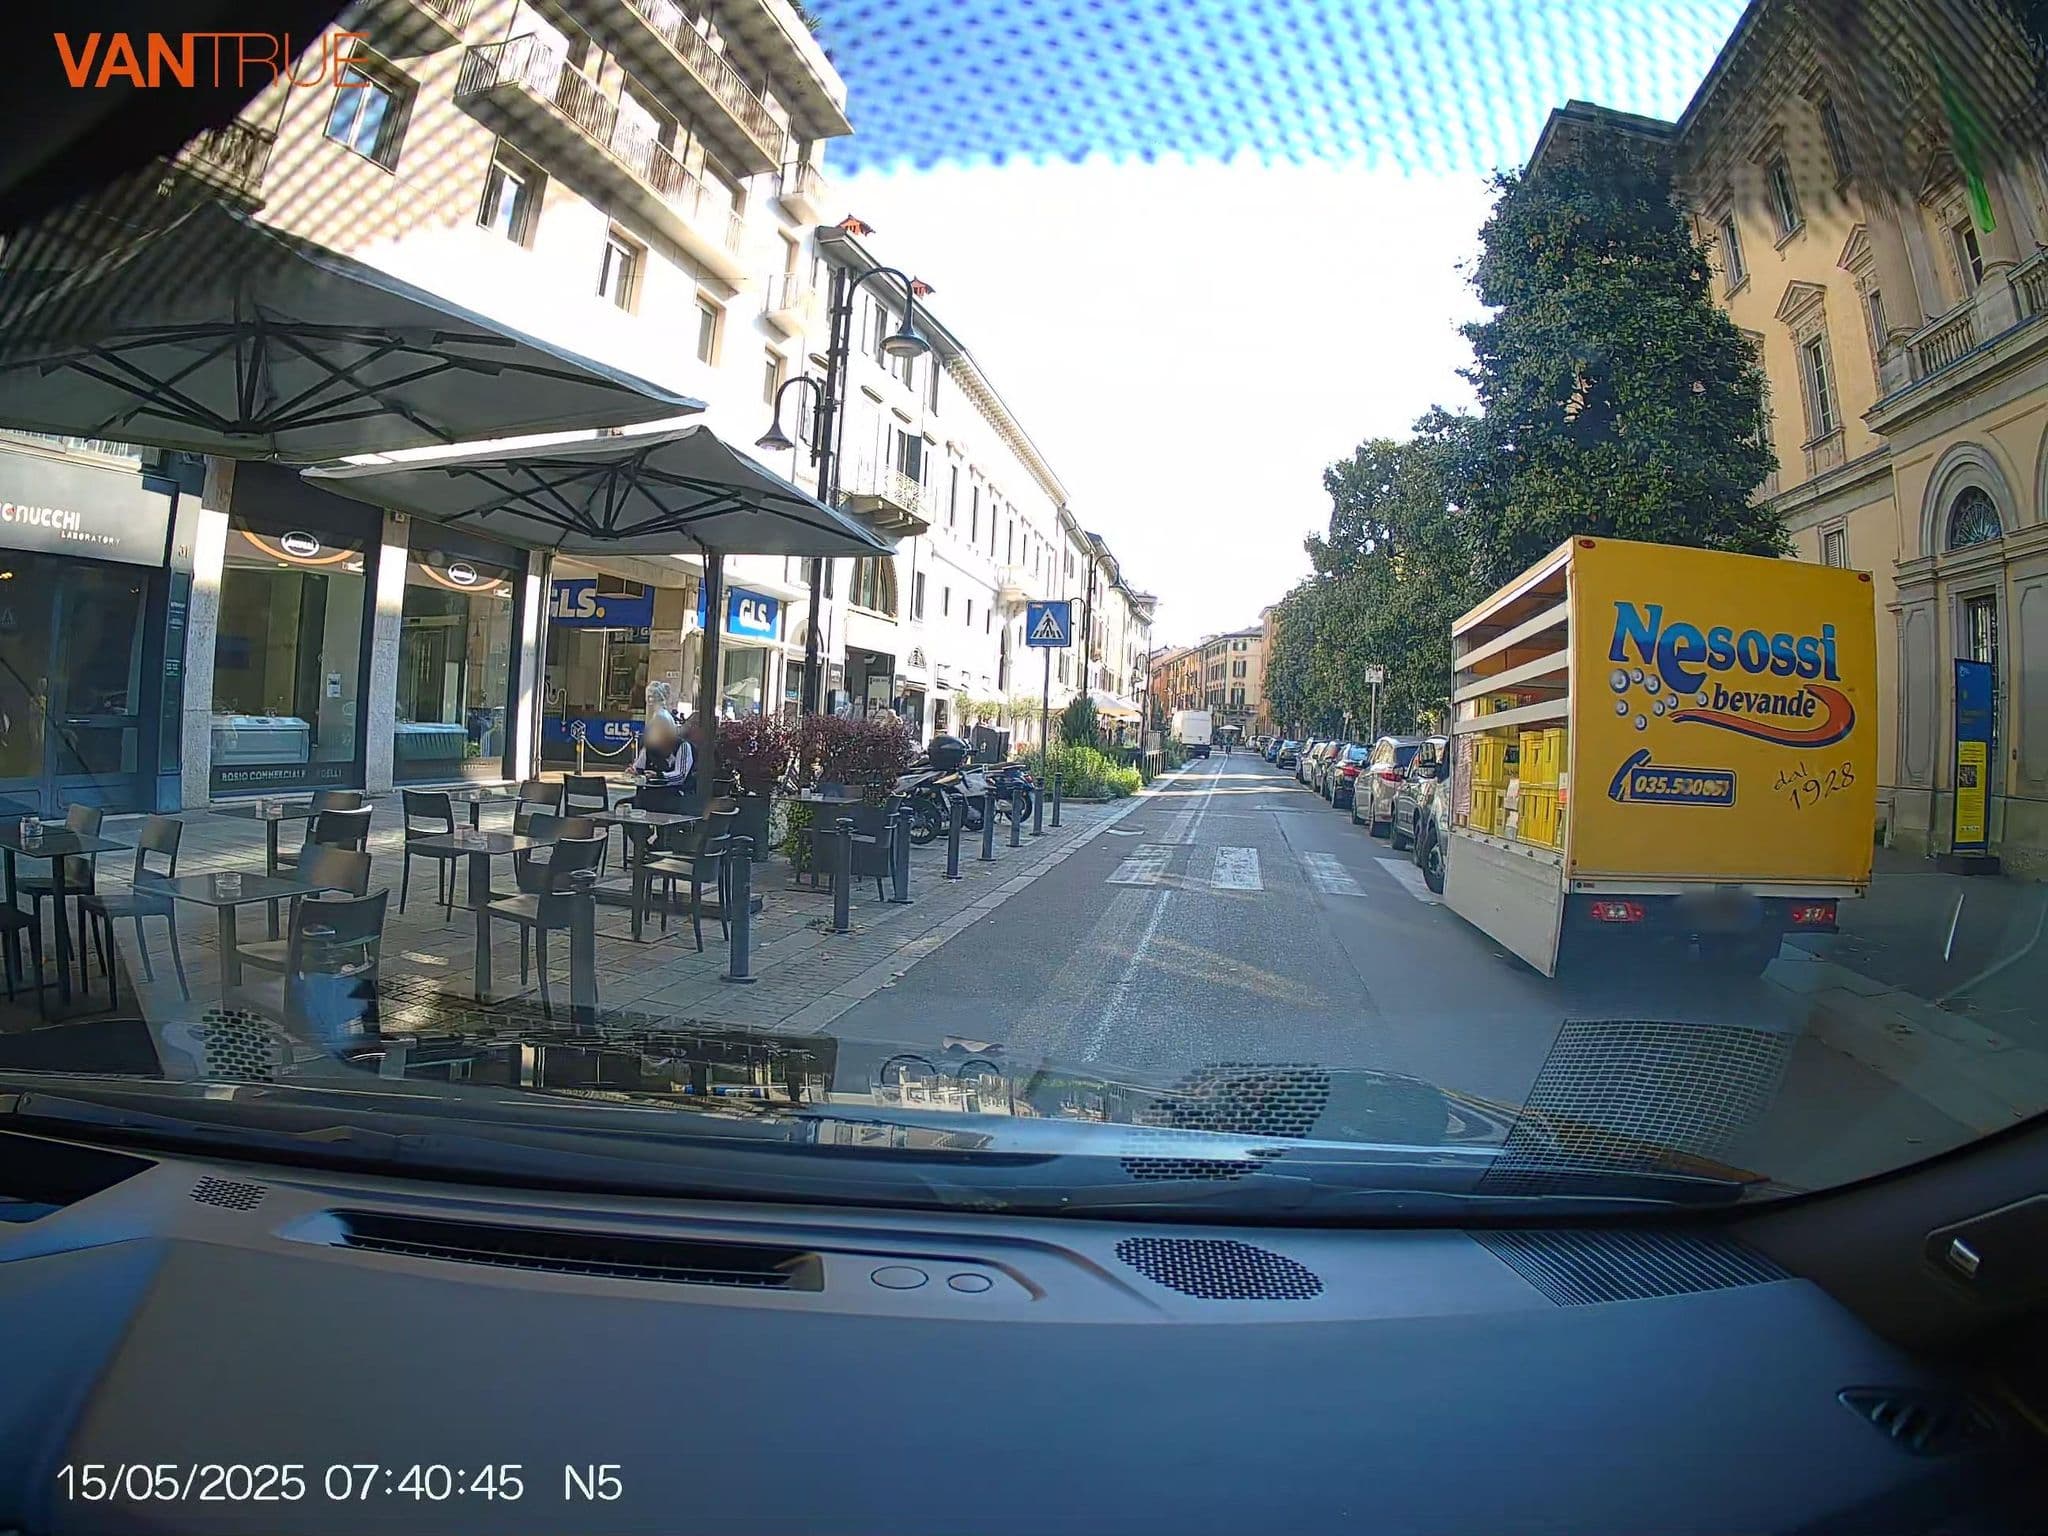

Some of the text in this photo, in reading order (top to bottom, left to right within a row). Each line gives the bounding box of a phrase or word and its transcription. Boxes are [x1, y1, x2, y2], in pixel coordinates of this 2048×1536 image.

[61, 530, 121, 546] LABORATORY
[1607, 600, 1842, 694] Nesossi
[1712, 682, 1816, 718] bevande
[1774, 761, 1809, 791] dal
[1789, 761, 1855, 811] 1928
